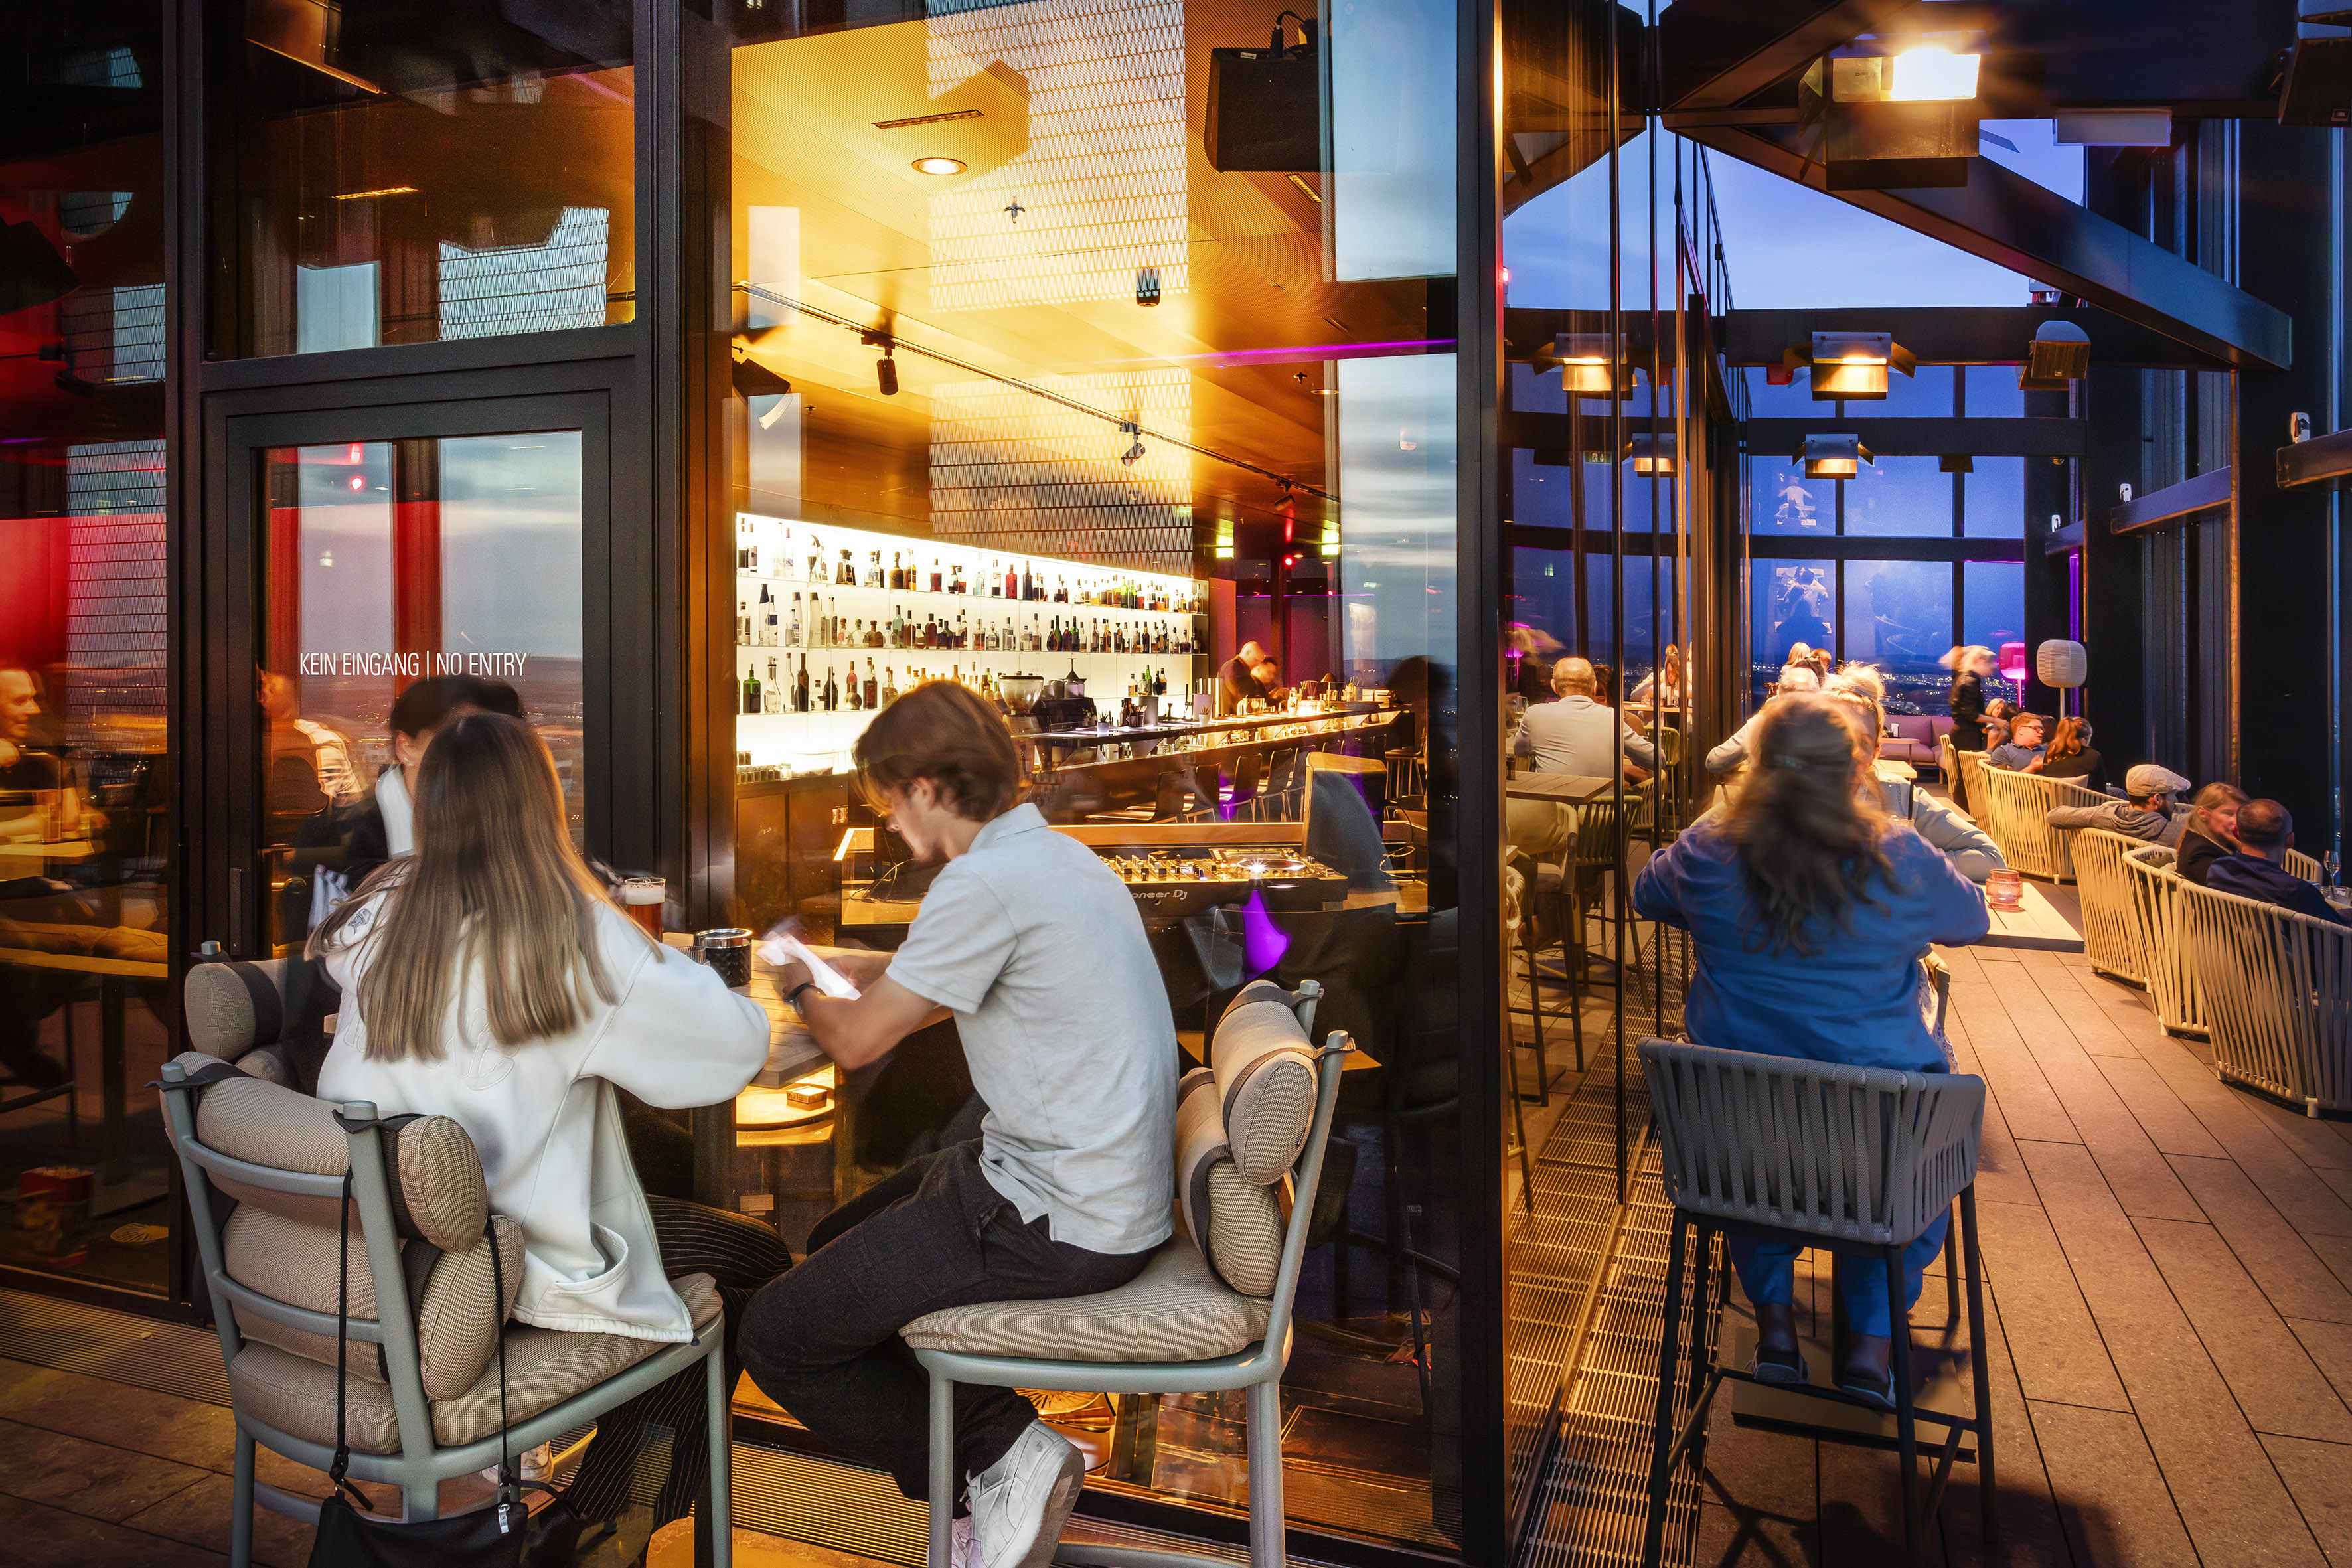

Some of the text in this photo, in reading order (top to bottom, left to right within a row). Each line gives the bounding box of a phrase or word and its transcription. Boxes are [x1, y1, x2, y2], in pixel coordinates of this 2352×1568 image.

[300, 653, 336, 676] KEIN
[343, 653, 420, 676] EINGANG
[437, 653, 463, 676] NO
[469, 653, 527, 676] ENTRY
